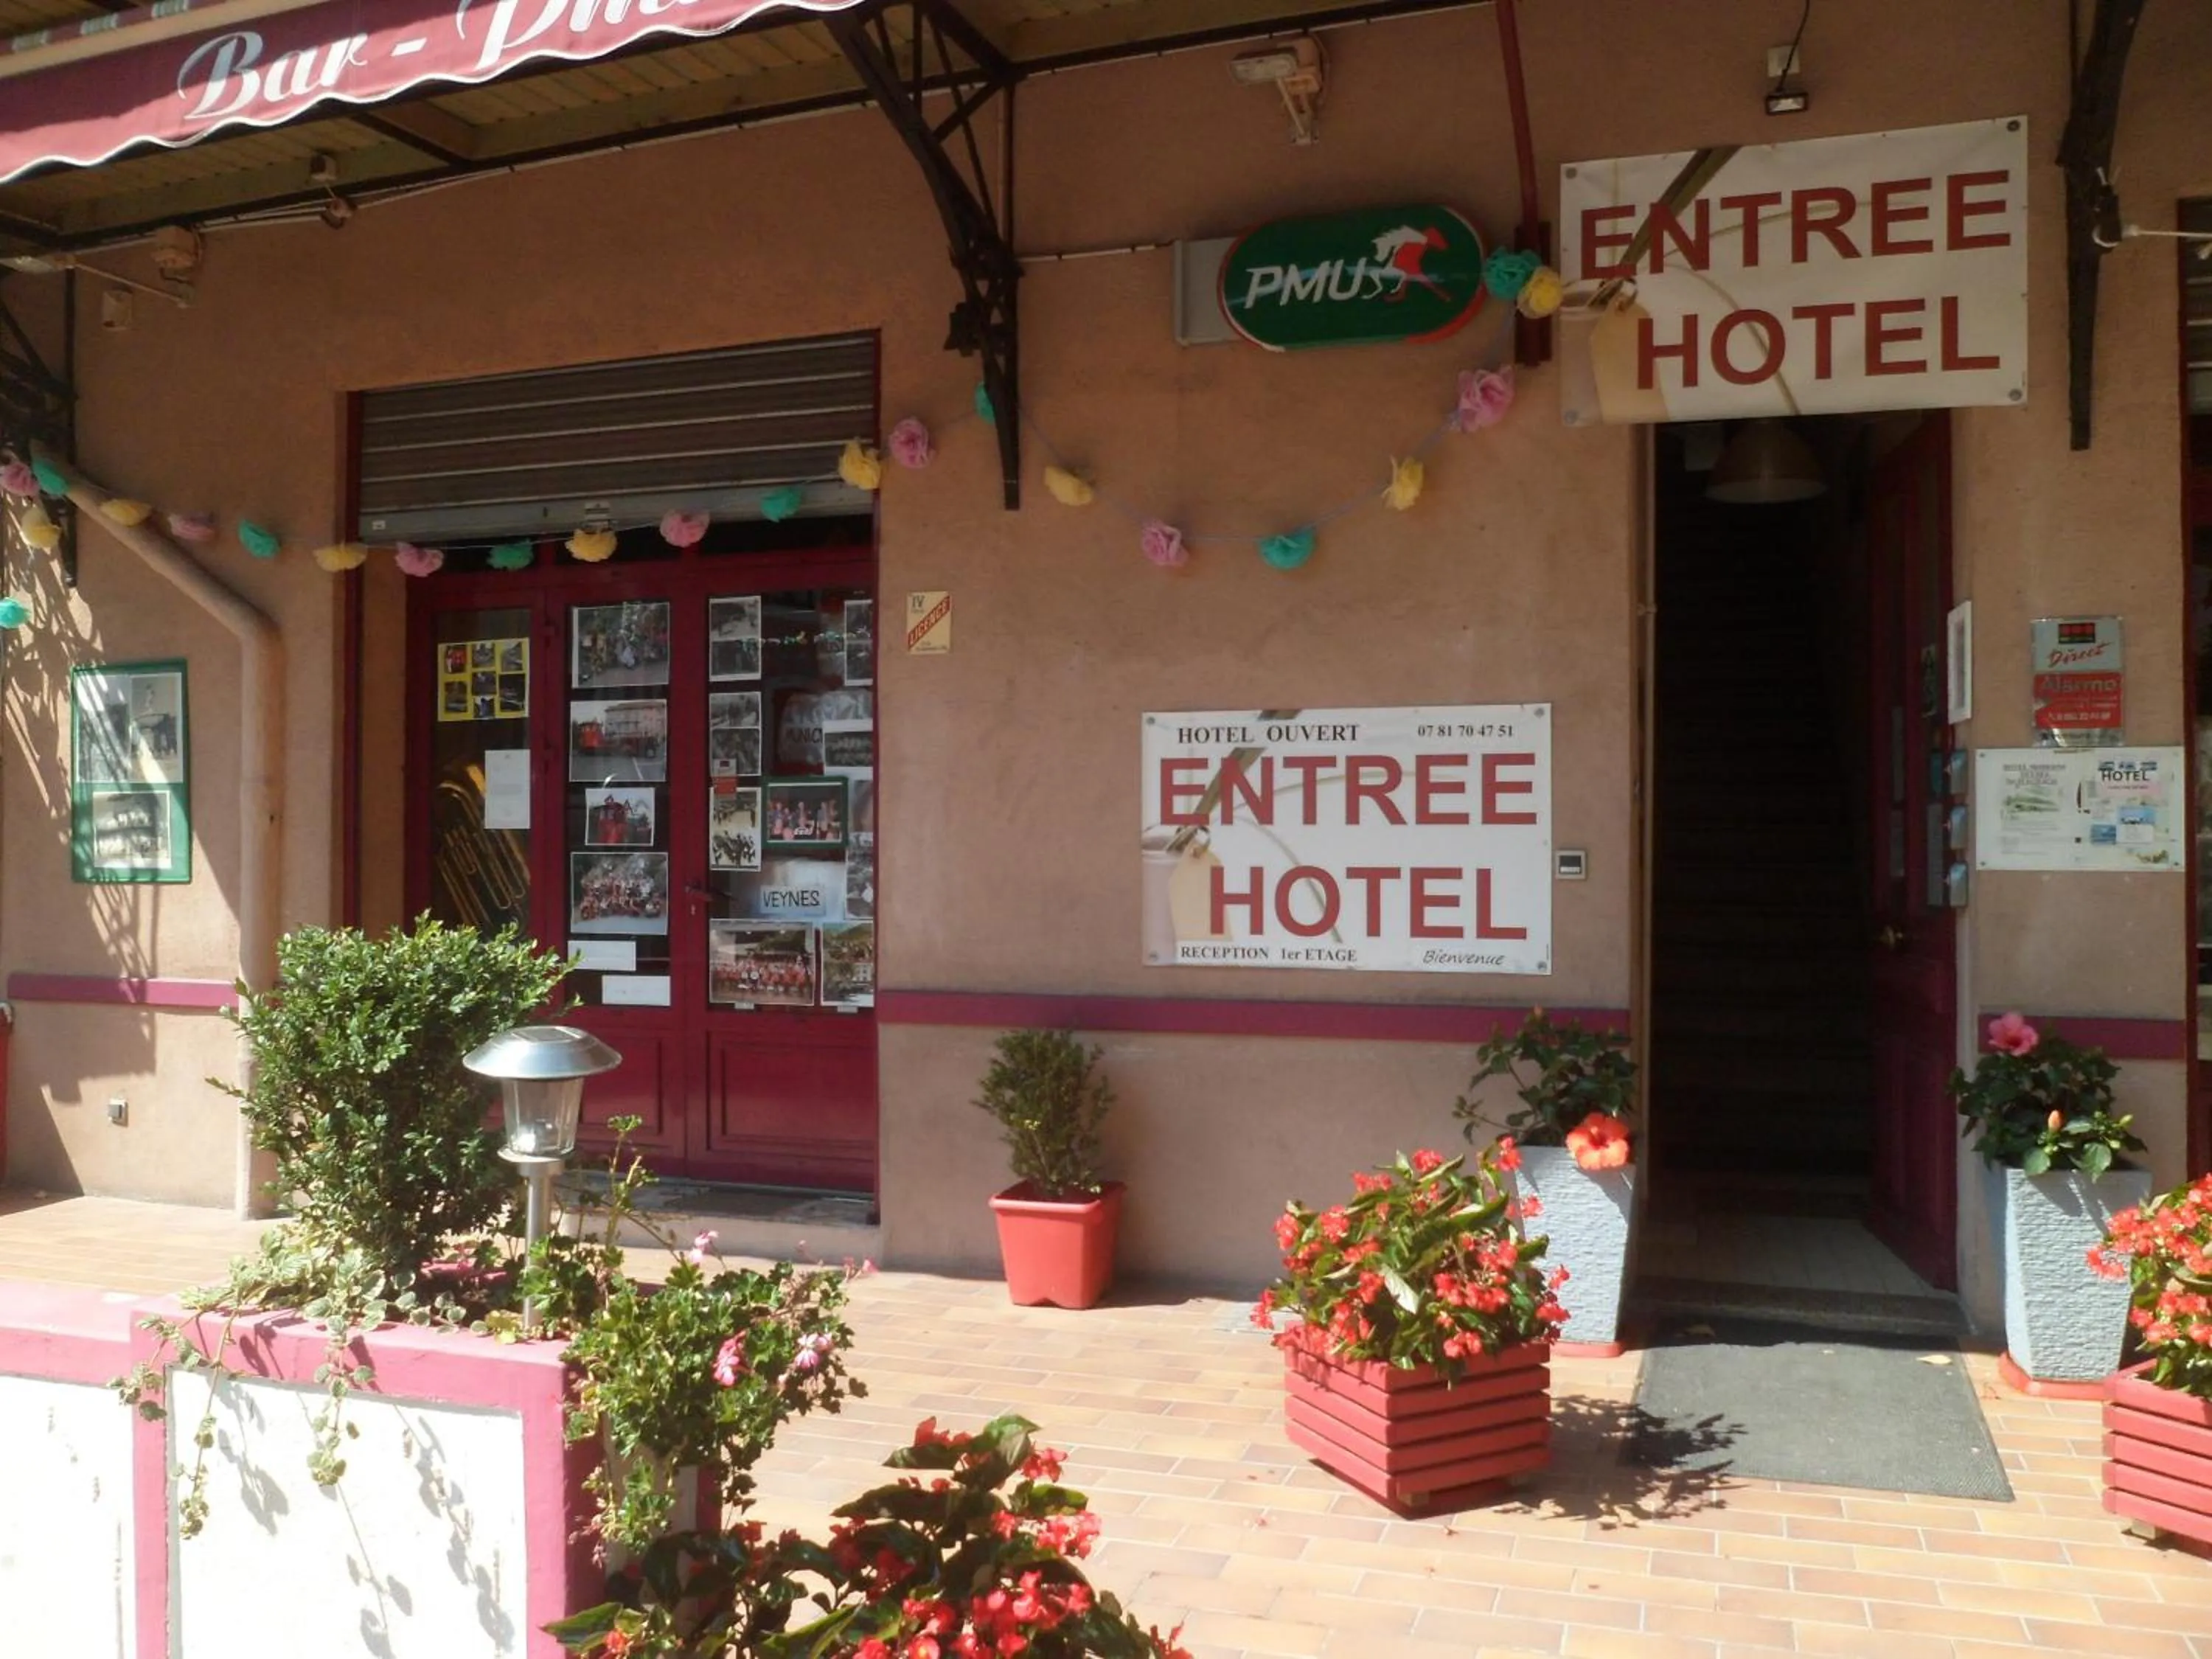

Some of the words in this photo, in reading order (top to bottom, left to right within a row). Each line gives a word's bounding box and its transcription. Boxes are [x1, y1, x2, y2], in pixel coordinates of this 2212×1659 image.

[177, 31, 368, 119] Bar
[1580, 169, 2011, 281] ENTREE
[1245, 257, 1367, 310] PMU
[1636, 295, 2000, 391] HOTEL
[1178, 726, 1254, 744] HOTEL
[1266, 724, 1360, 742] OUVERT
[1417, 724, 1434, 737] 07
[1438, 724, 1453, 737] 81
[1457, 724, 1474, 737] 70
[1477, 724, 1494, 737] 47
[1498, 724, 1513, 737] 51
[1160, 752, 1537, 827] ENTREE
[2101, 771, 2150, 782] HOTEL
[762, 889, 821, 908] VEYNES
[1209, 865, 1528, 941] HOTEL
[1180, 945, 1270, 959] RECEPTION
[1281, 947, 1302, 960] 1er
[1305, 948, 1358, 962] ETAGE
[1422, 948, 1506, 966] Bienvenue
